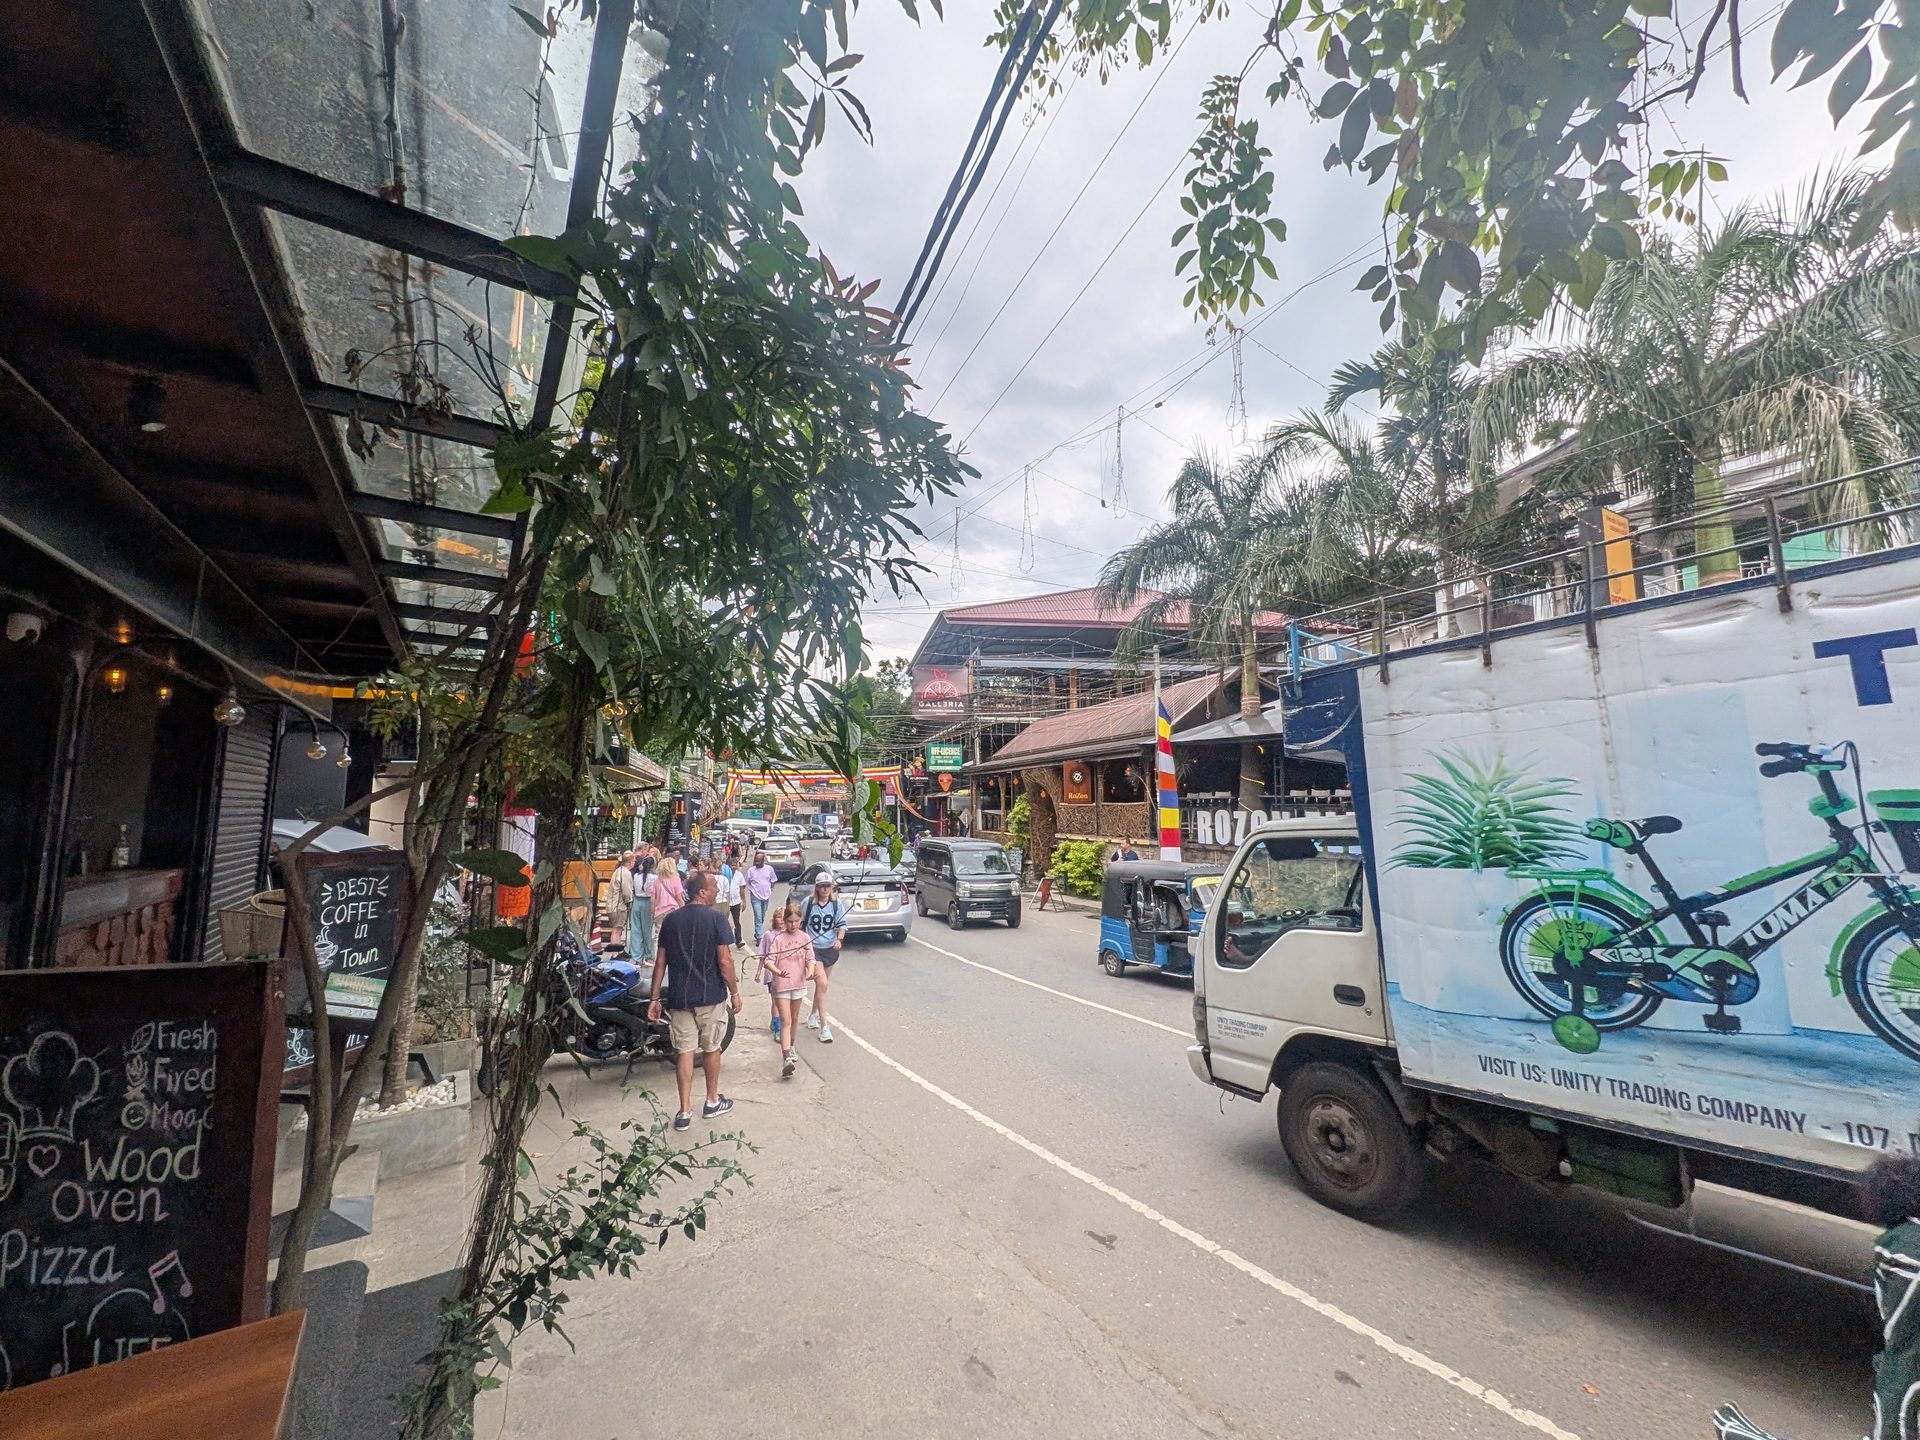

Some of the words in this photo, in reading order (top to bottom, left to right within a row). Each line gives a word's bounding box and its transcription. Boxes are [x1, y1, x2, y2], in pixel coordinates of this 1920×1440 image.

[1197, 810, 1291, 846] ROZ
[336, 878, 379, 901] BEST
[320, 901, 380, 926] COFFE
[811, 914, 834, 933] 89
[354, 923, 369, 939] in
[339, 947, 379, 969] Town
[157, 1019, 218, 1051] Fresh
[153, 1055, 216, 1094] Fired
[1478, 1055, 1517, 1078] VISIT
[1521, 1062, 1549, 1084] US:
[1551, 1068, 1603, 1094] UNITY
[1606, 1078, 1692, 1111] TRADING
[1697, 1094, 1807, 1134] COMPANY
[79, 1118, 202, 1183] Wood
[52, 1181, 171, 1222] Oven
[0, 1228, 125, 1289] Pizza
